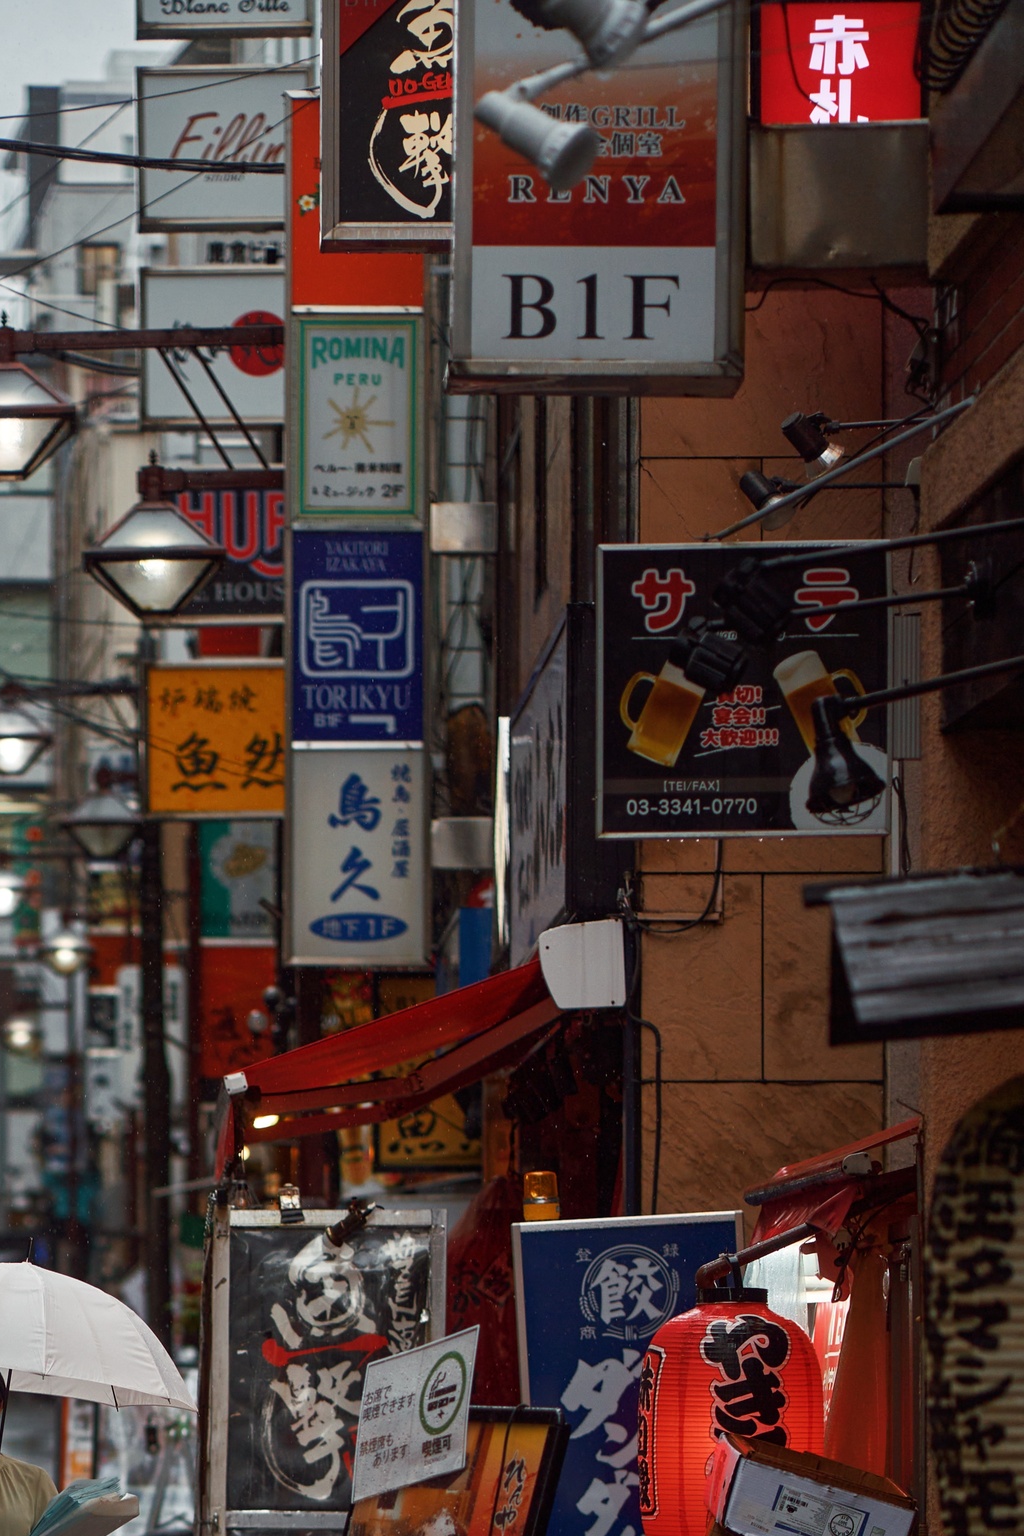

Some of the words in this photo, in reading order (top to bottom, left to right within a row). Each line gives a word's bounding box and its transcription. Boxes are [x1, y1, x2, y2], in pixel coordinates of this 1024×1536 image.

[501, 273, 680, 340] B1F
[311, 336, 405, 369] ROMINA
[333, 373, 382, 386] PERU
[325, 541, 389, 556] YAKITORI
[326, 557, 387, 572] IZAKAYA
[301, 684, 412, 710] TORIKYU
[313, 713, 343, 728] B1F
[712, 707, 765, 726] 宴会!!
[700, 728, 779, 748] 大歓迎!!!
[626, 798, 758, 816] 03-3341-0770
[327, 772, 382, 903] 鳥久
[589, 1258, 665, 1326] 餃
[700, 1314, 791, 1447] やき
[359, 1434, 394, 1457] 禁煙席も
[421, 1434, 452, 1458] 喫煙可
